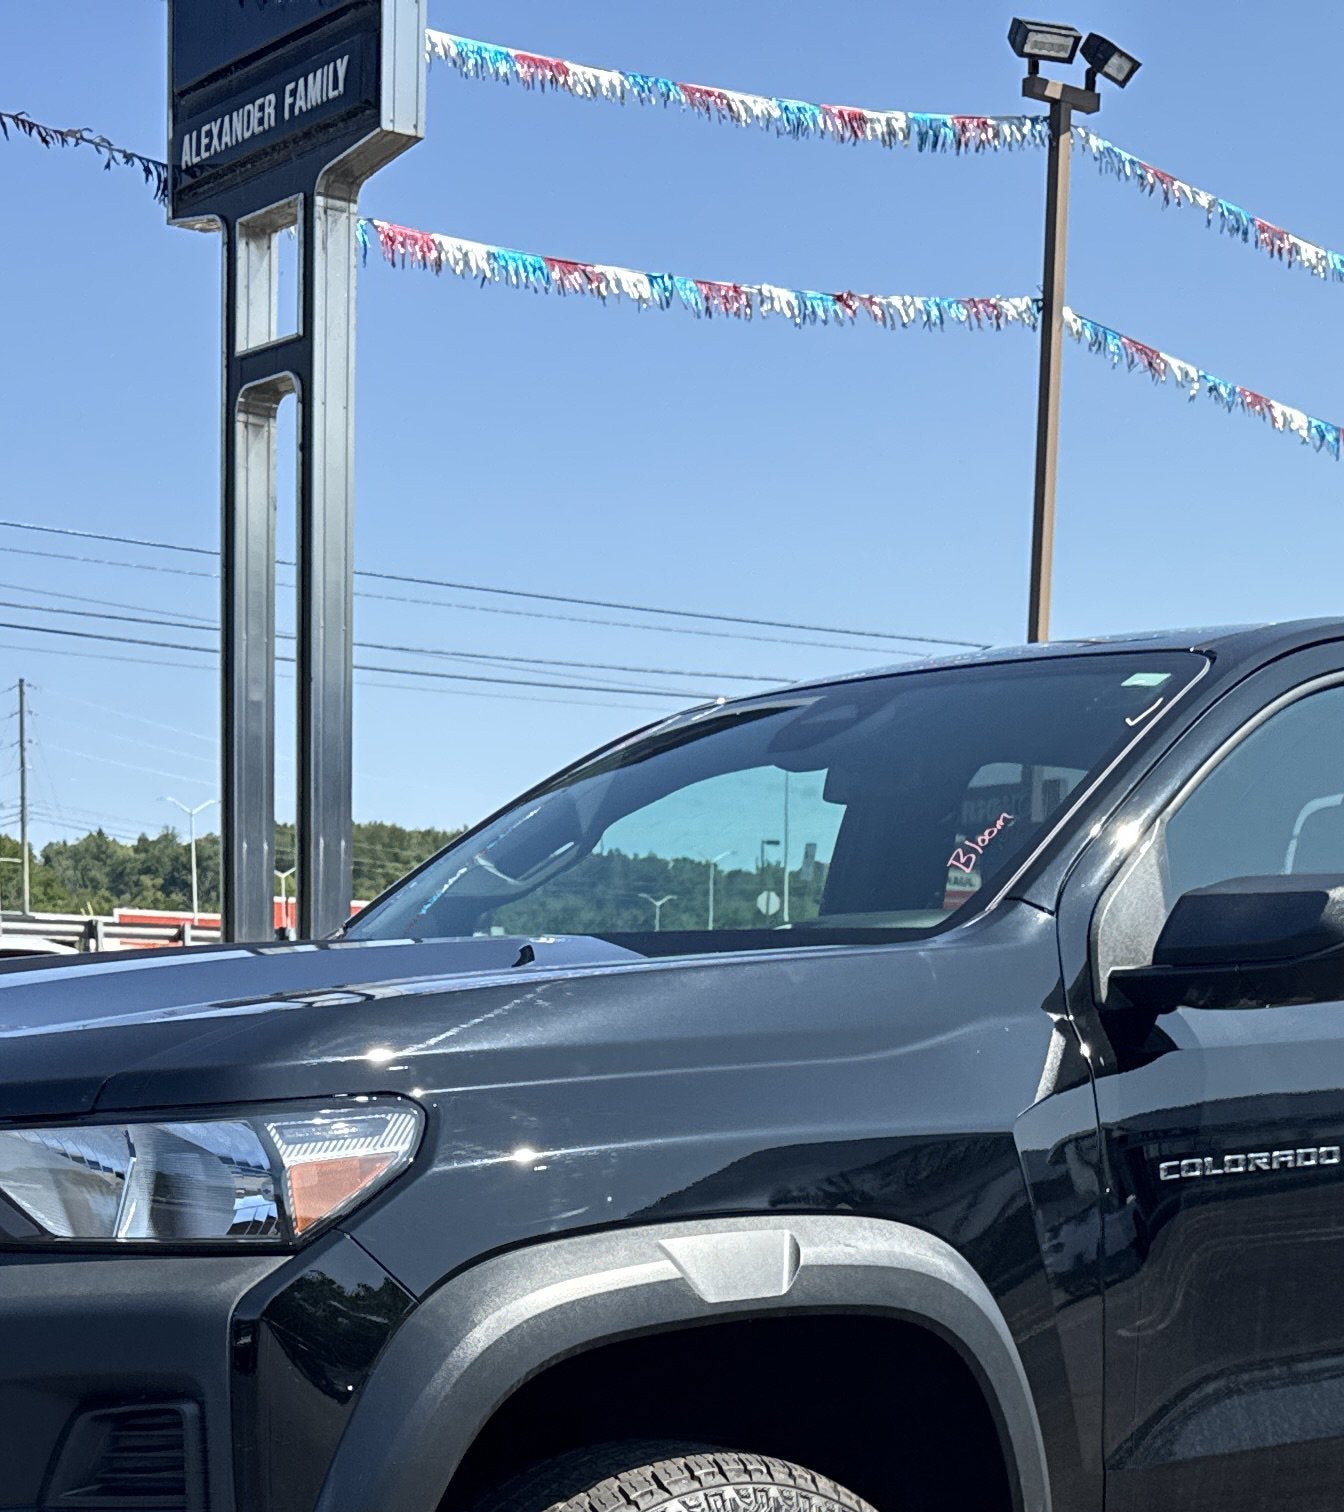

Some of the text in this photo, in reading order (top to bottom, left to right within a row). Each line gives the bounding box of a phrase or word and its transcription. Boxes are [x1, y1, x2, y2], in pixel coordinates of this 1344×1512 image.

[181, 54, 349, 170] ALEXANDER FAMILY
[946, 812, 1015, 873] Bloom
[1159, 1146, 1340, 1181] COLORADO
